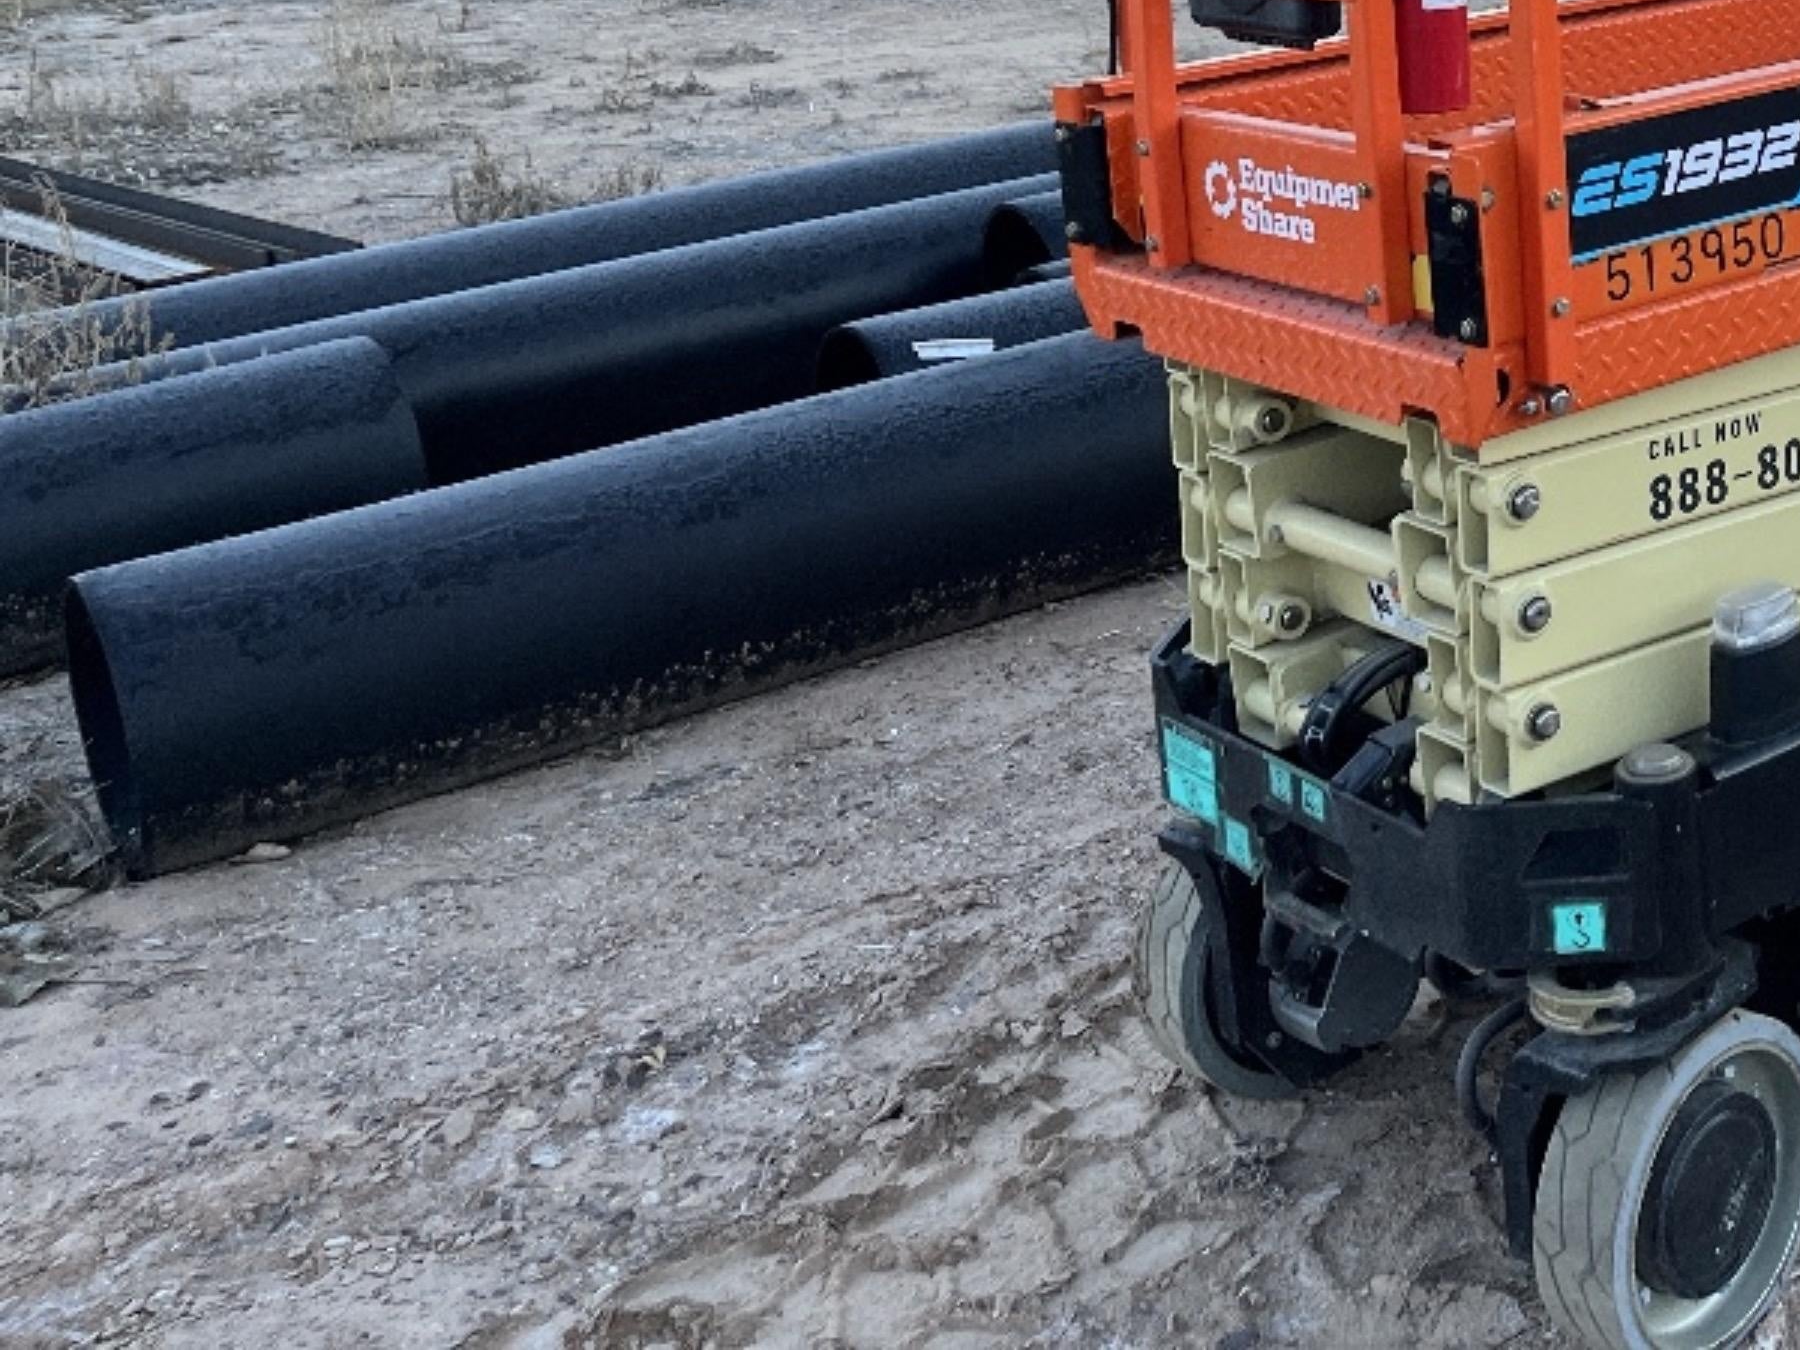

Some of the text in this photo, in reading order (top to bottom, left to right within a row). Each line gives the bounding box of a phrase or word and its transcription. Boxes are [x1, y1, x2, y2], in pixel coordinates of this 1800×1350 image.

[1240, 196, 1316, 244] Share
[1606, 213, 1784, 301] 513950
[1648, 410, 1763, 460] CALL NOW
